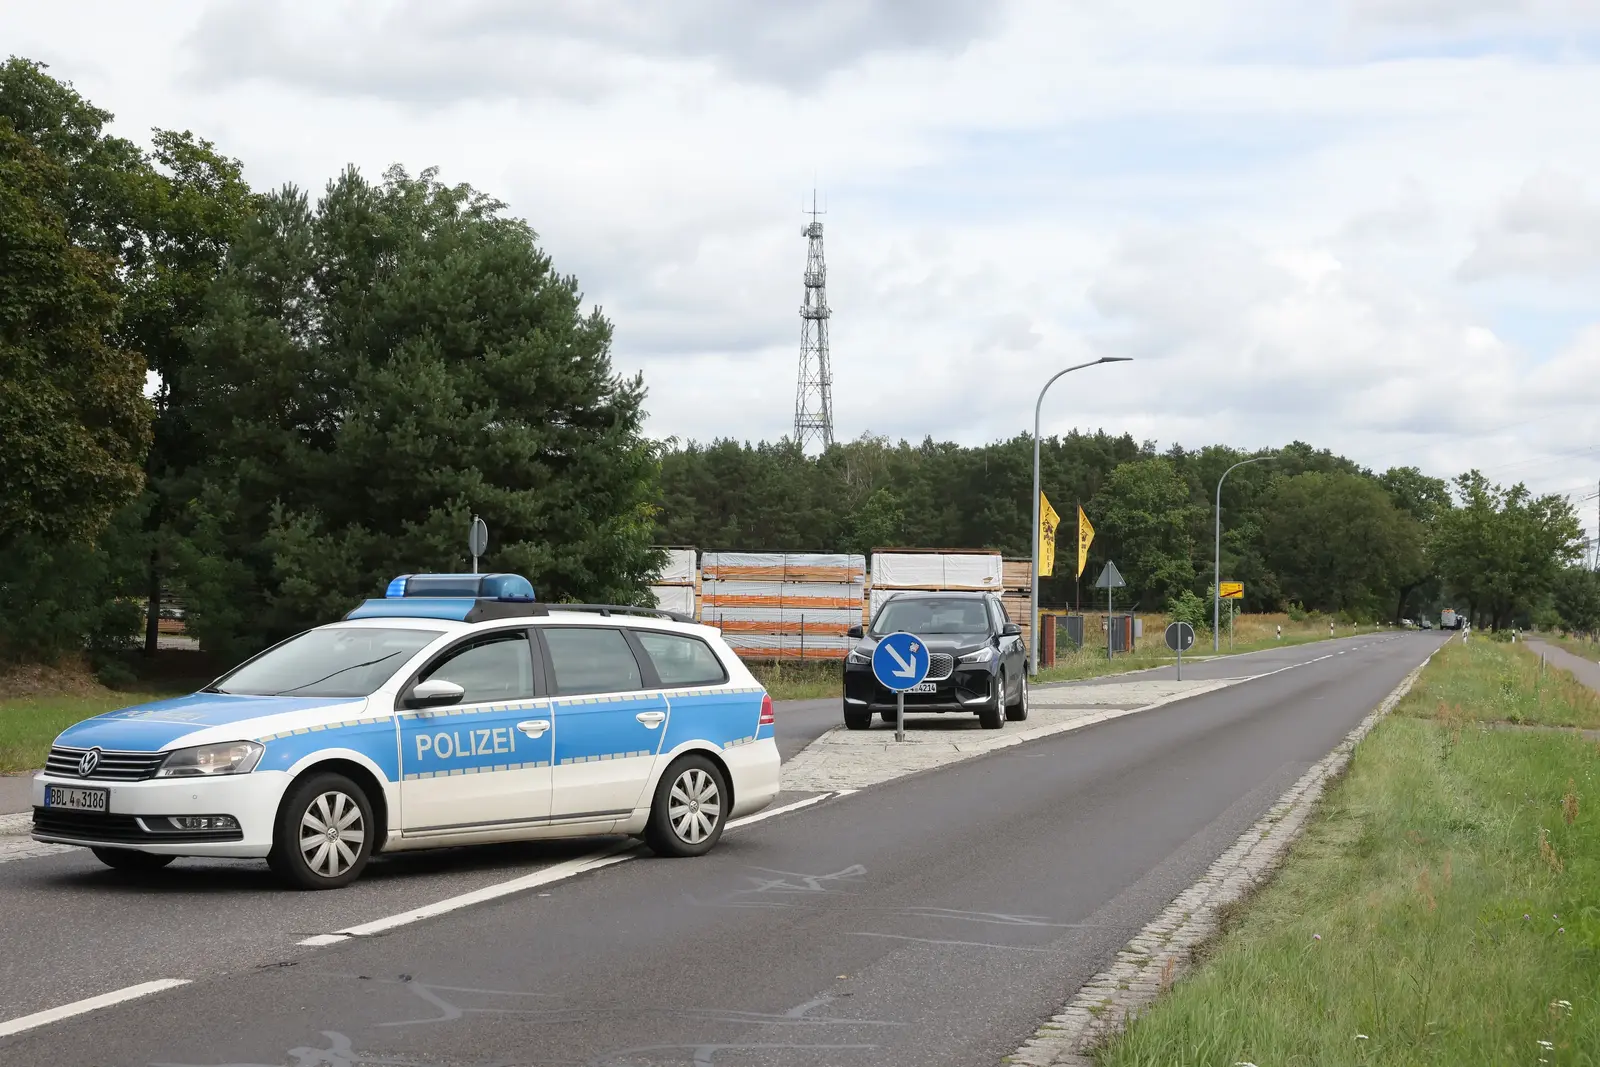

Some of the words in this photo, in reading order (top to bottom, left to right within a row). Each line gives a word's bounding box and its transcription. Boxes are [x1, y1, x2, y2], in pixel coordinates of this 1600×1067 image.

[918, 684, 936, 692] 4214
[416, 727, 516, 761] POLIZEI
[51, 789, 67, 806] BBL
[69, 790, 75, 807] 4
[81, 791, 104, 809] 3186
